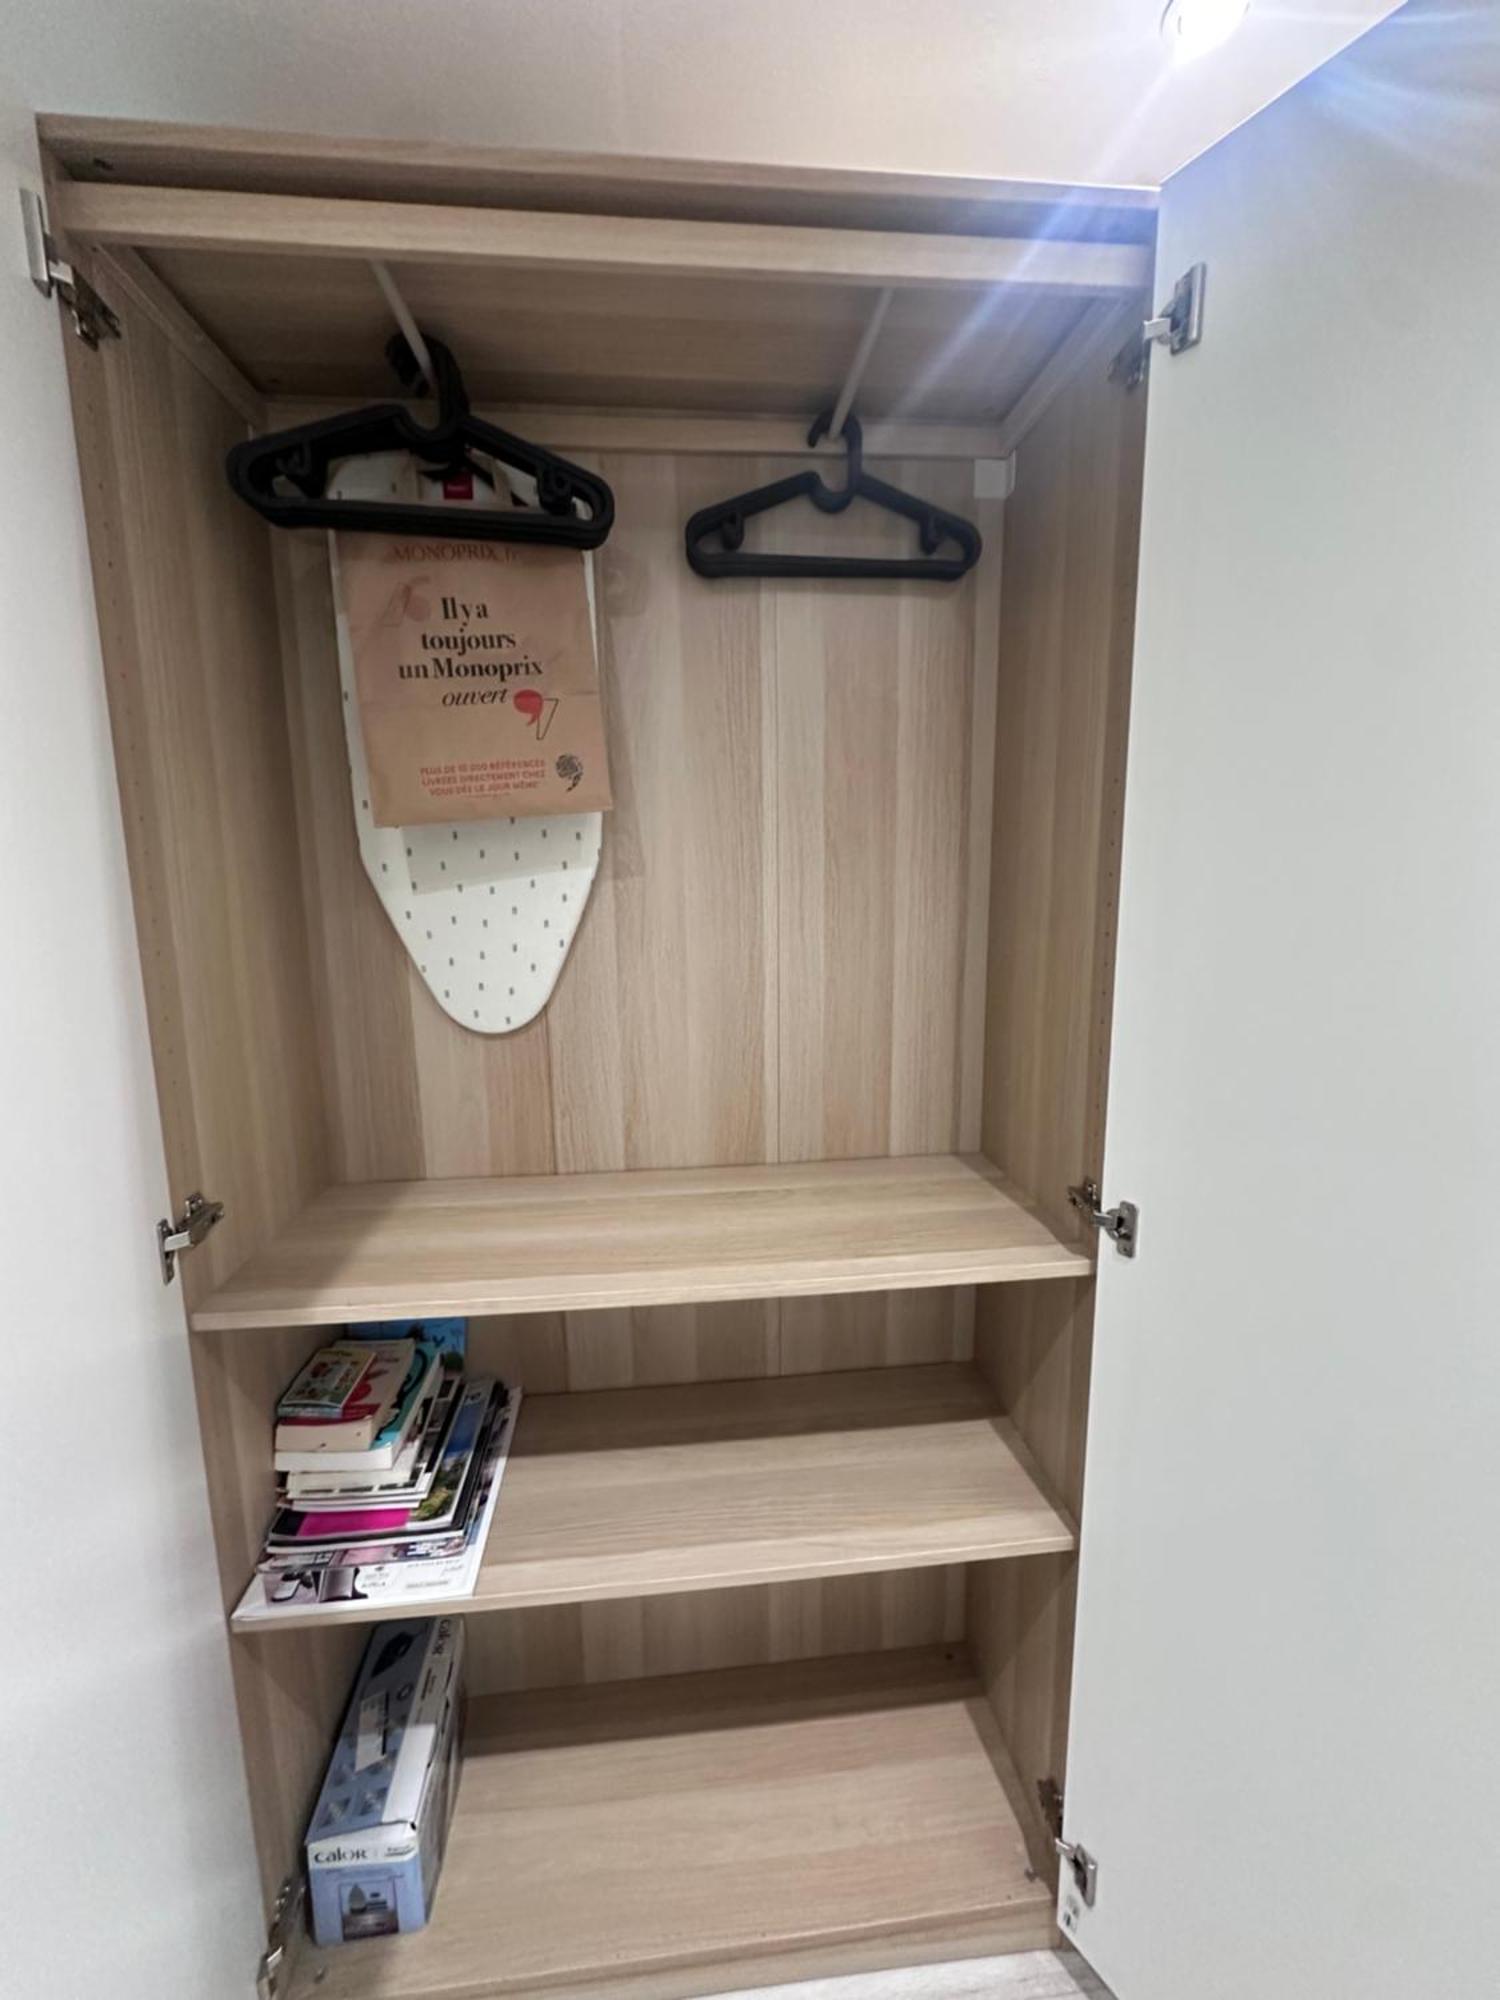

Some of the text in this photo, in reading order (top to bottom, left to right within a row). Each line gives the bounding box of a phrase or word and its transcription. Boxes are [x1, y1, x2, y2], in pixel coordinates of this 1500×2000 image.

[440, 597, 489, 627] Il y a
[420, 627, 517, 657] toujours
[398, 655, 544, 683] un Monoprix
[441, 688, 508, 708] ouvert
